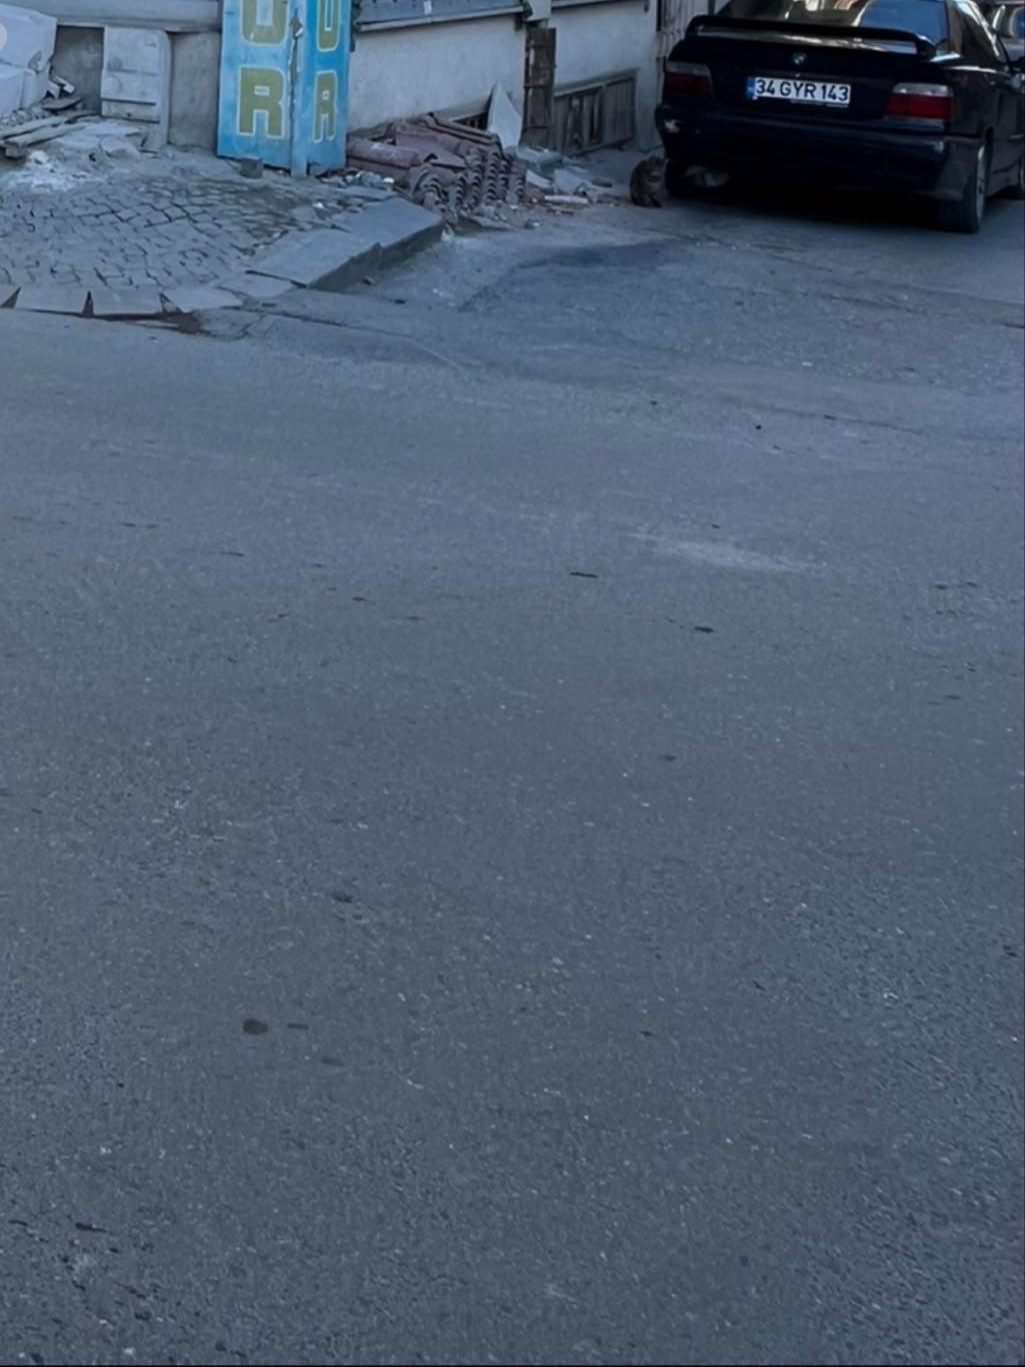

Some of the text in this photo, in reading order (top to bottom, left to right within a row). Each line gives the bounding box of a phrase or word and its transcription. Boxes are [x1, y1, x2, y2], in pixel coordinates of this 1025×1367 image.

[756, 79, 849, 102] 34 GYR 143
